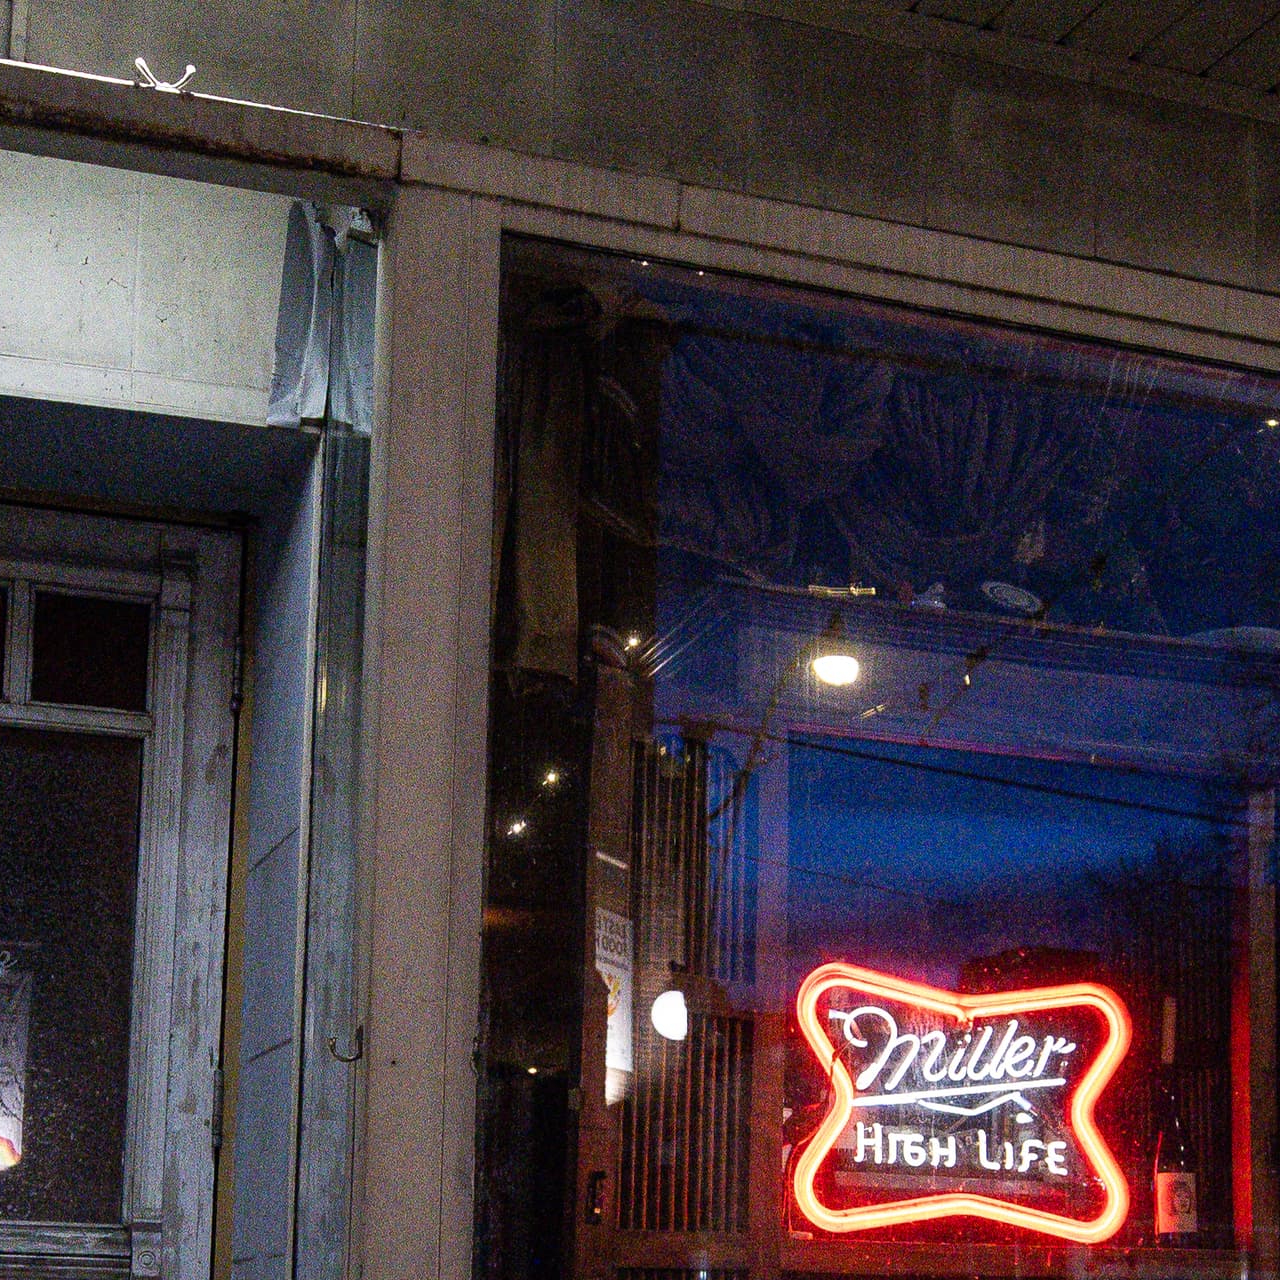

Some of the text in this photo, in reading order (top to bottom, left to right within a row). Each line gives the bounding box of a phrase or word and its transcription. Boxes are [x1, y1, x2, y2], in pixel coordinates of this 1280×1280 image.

[828, 1005, 1077, 1091] Miller
[853, 1121, 1069, 1176] HIGH LIFE
